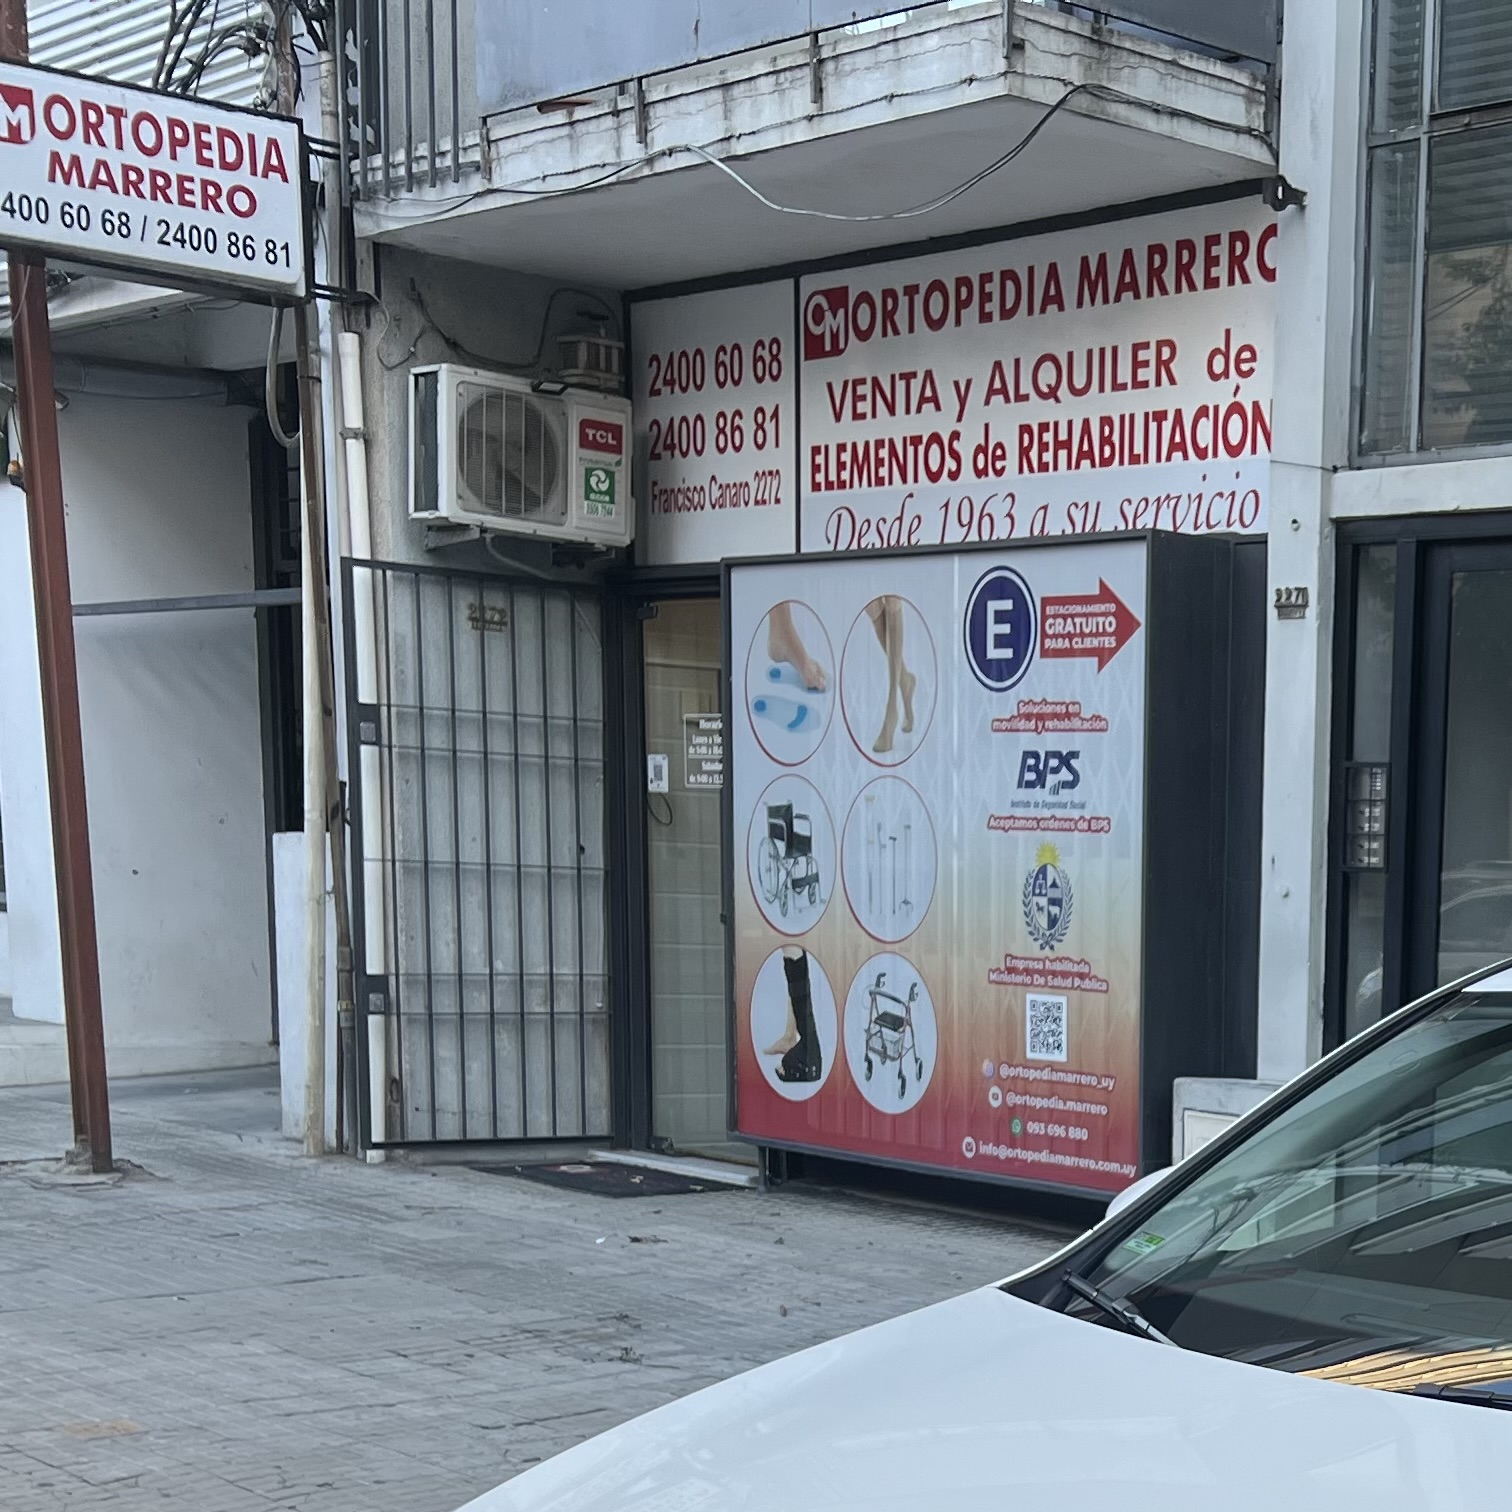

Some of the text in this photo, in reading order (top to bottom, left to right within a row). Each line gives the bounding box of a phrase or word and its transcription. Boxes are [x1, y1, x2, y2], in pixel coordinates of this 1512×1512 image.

[43, 93, 289, 183] ORTOPEDIA
[48, 150, 257, 218] MARRERO
[60, 201, 90, 231] 60
[101, 209, 131, 238] 68
[157, 219, 217, 254] 2400
[227, 232, 256, 260] 86
[265, 239, 290, 268] 81
[851, 263, 1066, 343] ORTOPEDIA
[649, 337, 782, 398] 2400 60 68
[826, 329, 1258, 424] VENTA y ALQUILER de
[585, 428, 616, 445] TCL
[649, 404, 781, 461] 2400 86 81
[811, 385, 1272, 493] ELEMENTOS de REHABILITACIÓN
[651, 469, 781, 516] Francisco Canaro 2272
[826, 471, 1260, 550] Desde 1963 a su servicio
[1045, 616, 1117, 634] GRATUITO
[1046, 603, 1116, 615] ESTACIONAMIENTO
[986, 599, 1013, 659] E
[1044, 636, 1116, 649] PARA CLIENTES
[993, 716, 1107, 733] movilidad y rehabilitación
[1019, 701, 1079, 713] Soluciones en
[1016, 750, 1080, 789] BPS
[990, 817, 1110, 831] Aceptamos ordenes de BPS
[990, 970, 1032, 984] Ministerio
[1033, 975, 1046, 985] De
[1048, 975, 1072, 987] Salud
[1007, 957, 1090, 973] Empresa habilitada
[1000, 1063, 1116, 1091] @ortopediamarrero_uy
[1006, 1091, 1108, 1116] @ortopedia.marrero
[1027, 1121, 1088, 1141] 093 696 880
[979, 1140, 1137, 1178] info@ortopediamarrero.com.uy
